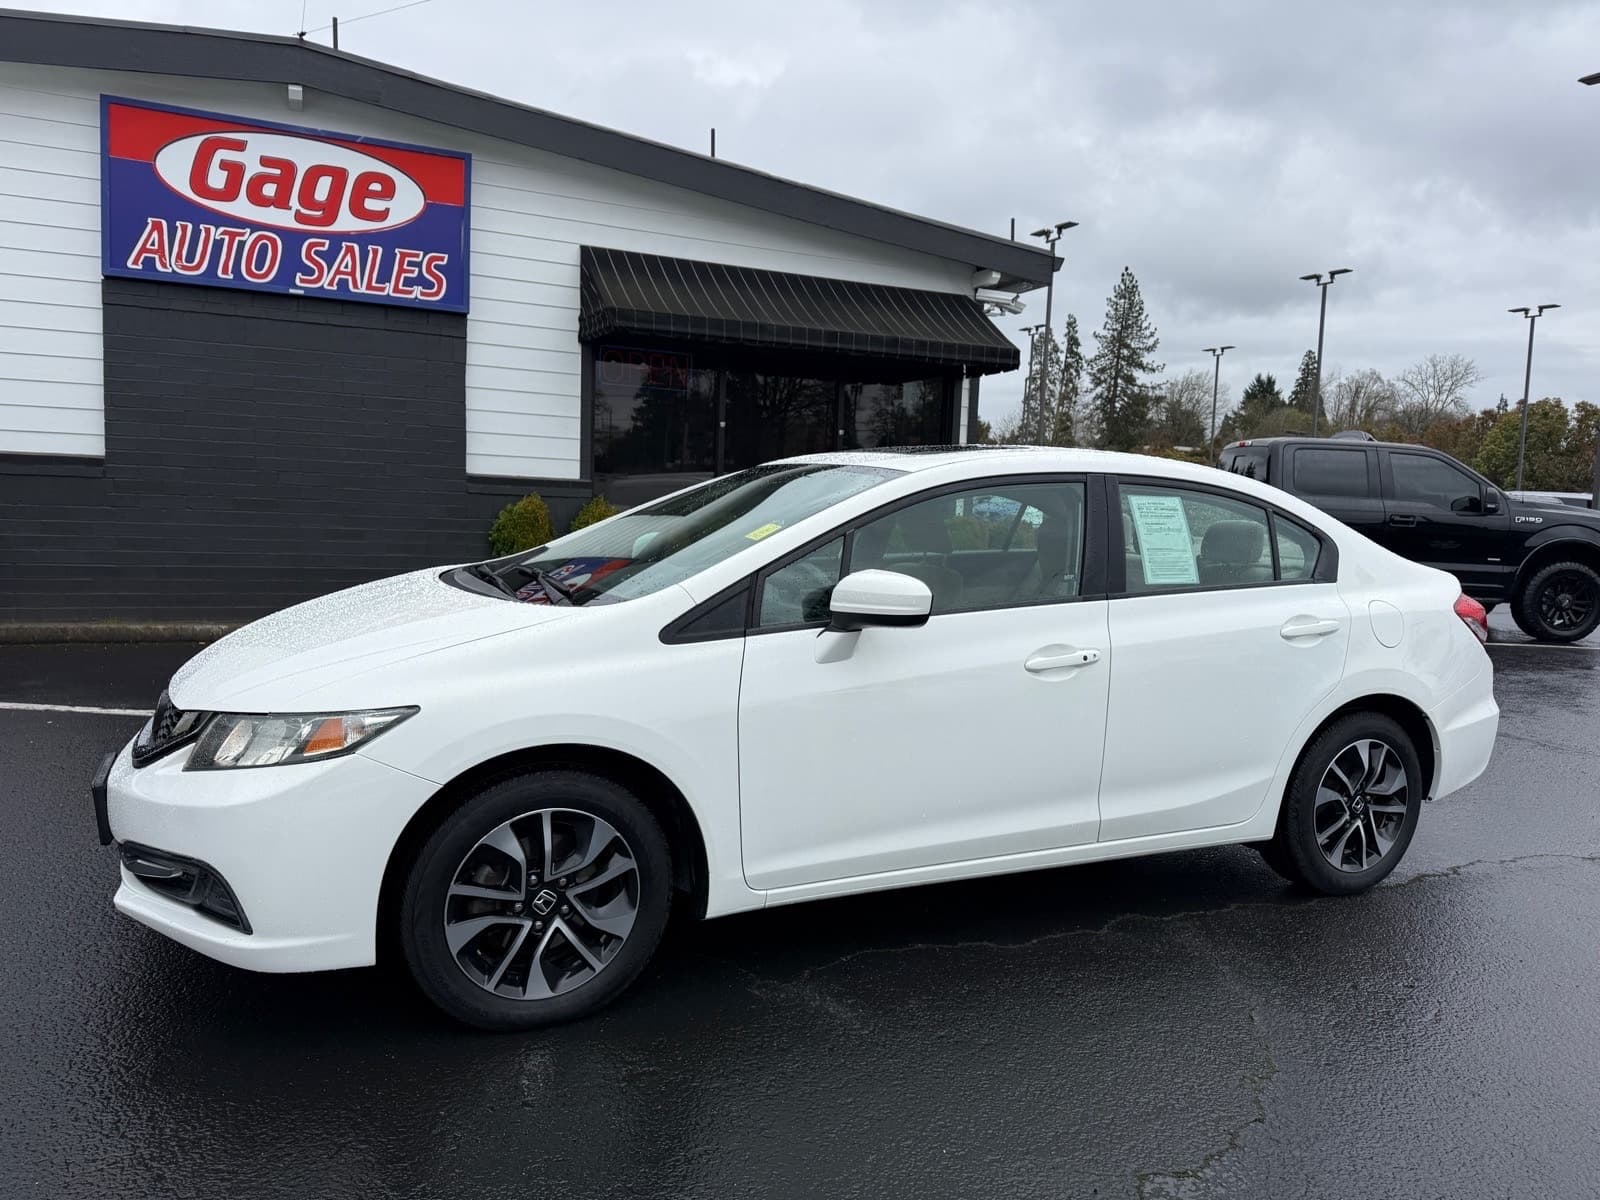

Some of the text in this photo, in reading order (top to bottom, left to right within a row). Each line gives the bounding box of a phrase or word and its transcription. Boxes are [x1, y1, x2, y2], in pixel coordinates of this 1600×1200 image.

[189, 136, 396, 227] Gage
[127, 218, 448, 300] AUTO SALES
